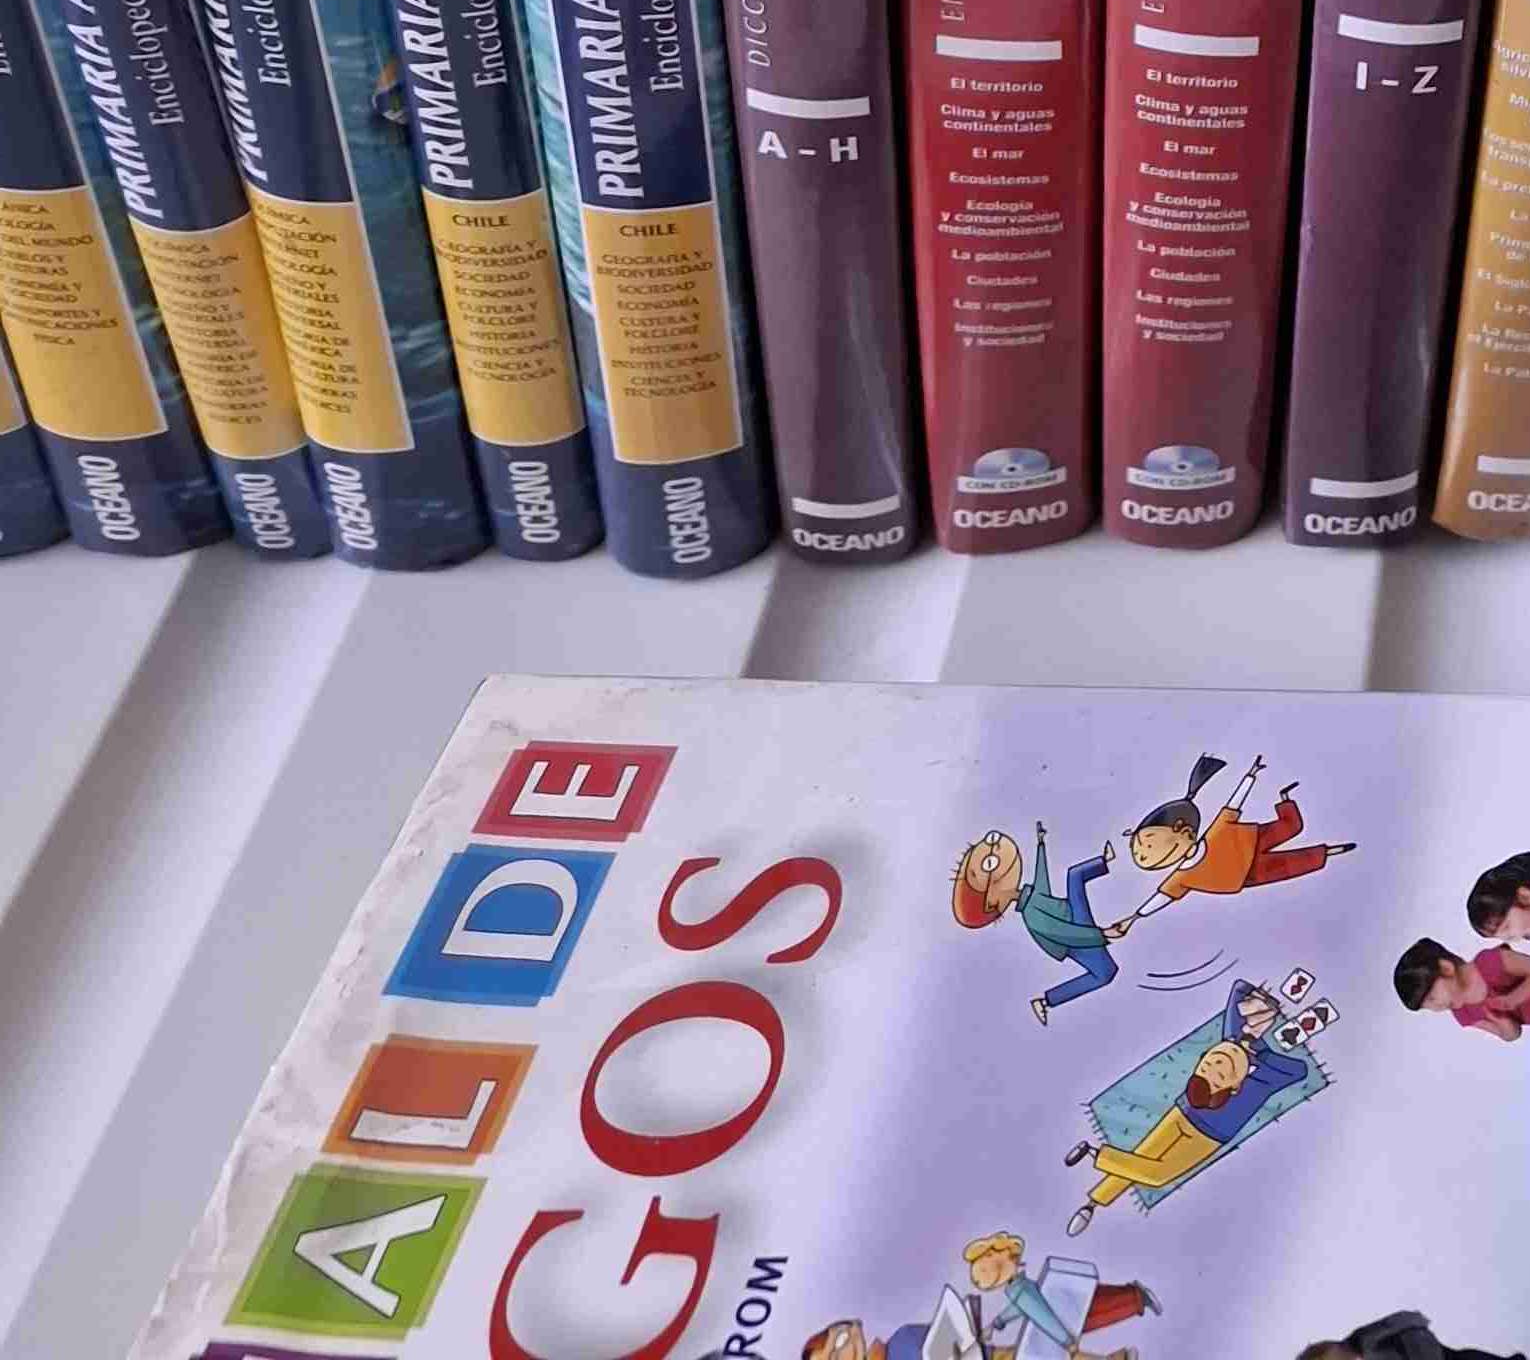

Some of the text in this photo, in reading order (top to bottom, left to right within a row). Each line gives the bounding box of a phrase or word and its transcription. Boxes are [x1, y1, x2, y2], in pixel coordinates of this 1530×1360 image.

[951, 78, 1043, 93] El territorio
[1147, 69, 1238, 88] El territorio
[1357, 61, 1437, 94] I Z
[941, 104, 1055, 120] Clima y aguas
[1135, 94, 1248, 115] Clima y aguas
[67, 24, 163, 219] PRIMARIA
[944, 120, 1052, 133] continentales
[1137, 110, 1245, 129] continentales
[758, 131, 859, 162] A H
[972, 147, 1024, 159] El mar
[1164, 141, 1215, 155] El mar
[949, 172, 1049, 185] Ecosistemas
[1140, 163, 1238, 180] Ecosistemas
[966, 200, 1033, 212] Ecología
[1155, 192, 1221, 208] Ecología
[452, 214, 511, 228] CHILE
[941, 211, 1060, 223] y conservación
[619, 224, 678, 237] CHILE
[938, 223, 1063, 237] medioambiental
[953, 249, 970, 260] La
[77, 455, 140, 541] OCEANO
[324, 462, 378, 551] OCEANO
[509, 461, 560, 543] OCEANO
[234, 473, 295, 550] OCEANO
[662, 477, 712, 564] OCEANO
[954, 500, 1068, 528] OCEANO
[1121, 499, 1234, 525] OCEANO
[1305, 507, 1417, 536] OCEANO
[793, 526, 905, 551] OCEANO
